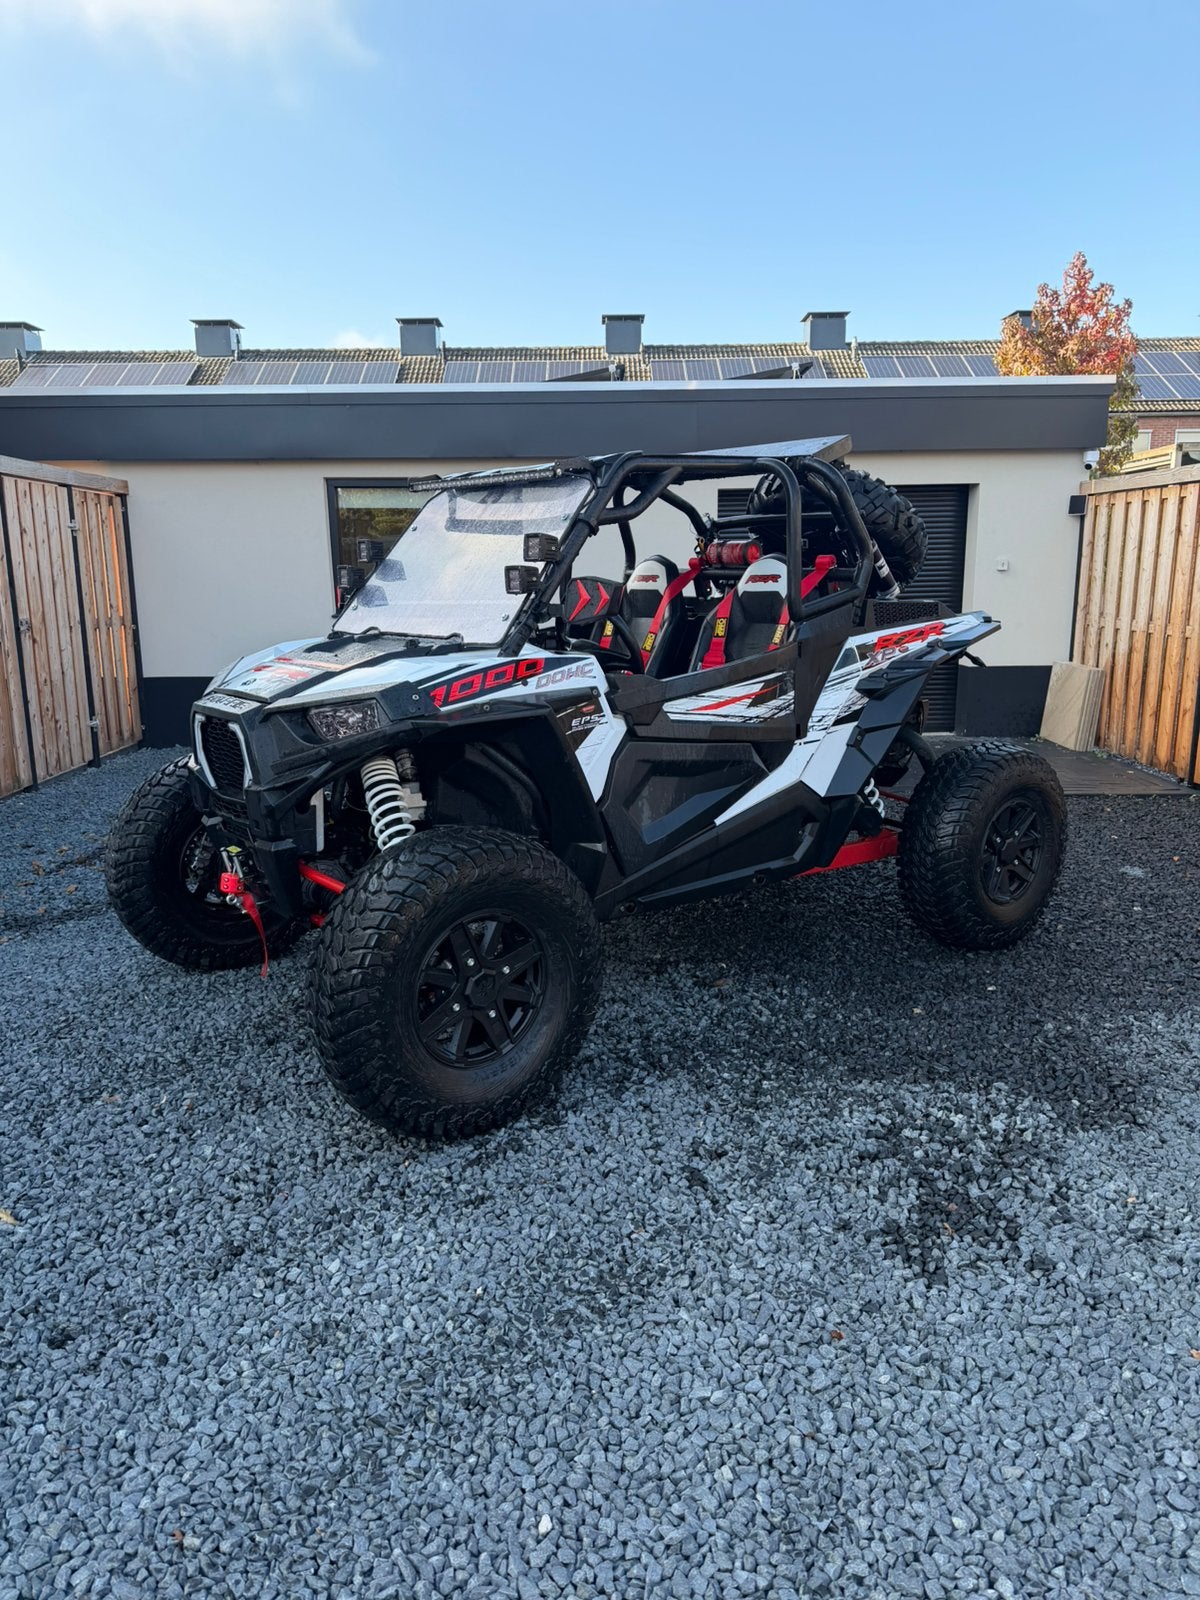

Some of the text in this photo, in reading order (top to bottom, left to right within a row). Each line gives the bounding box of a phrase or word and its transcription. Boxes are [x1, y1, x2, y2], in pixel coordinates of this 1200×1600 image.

[874, 621, 945, 653] RZR
[863, 647, 898, 669] XP
[429, 657, 545, 707] 1000
[535, 662, 595, 690] DOHC
[571, 713, 604, 727] EPS
